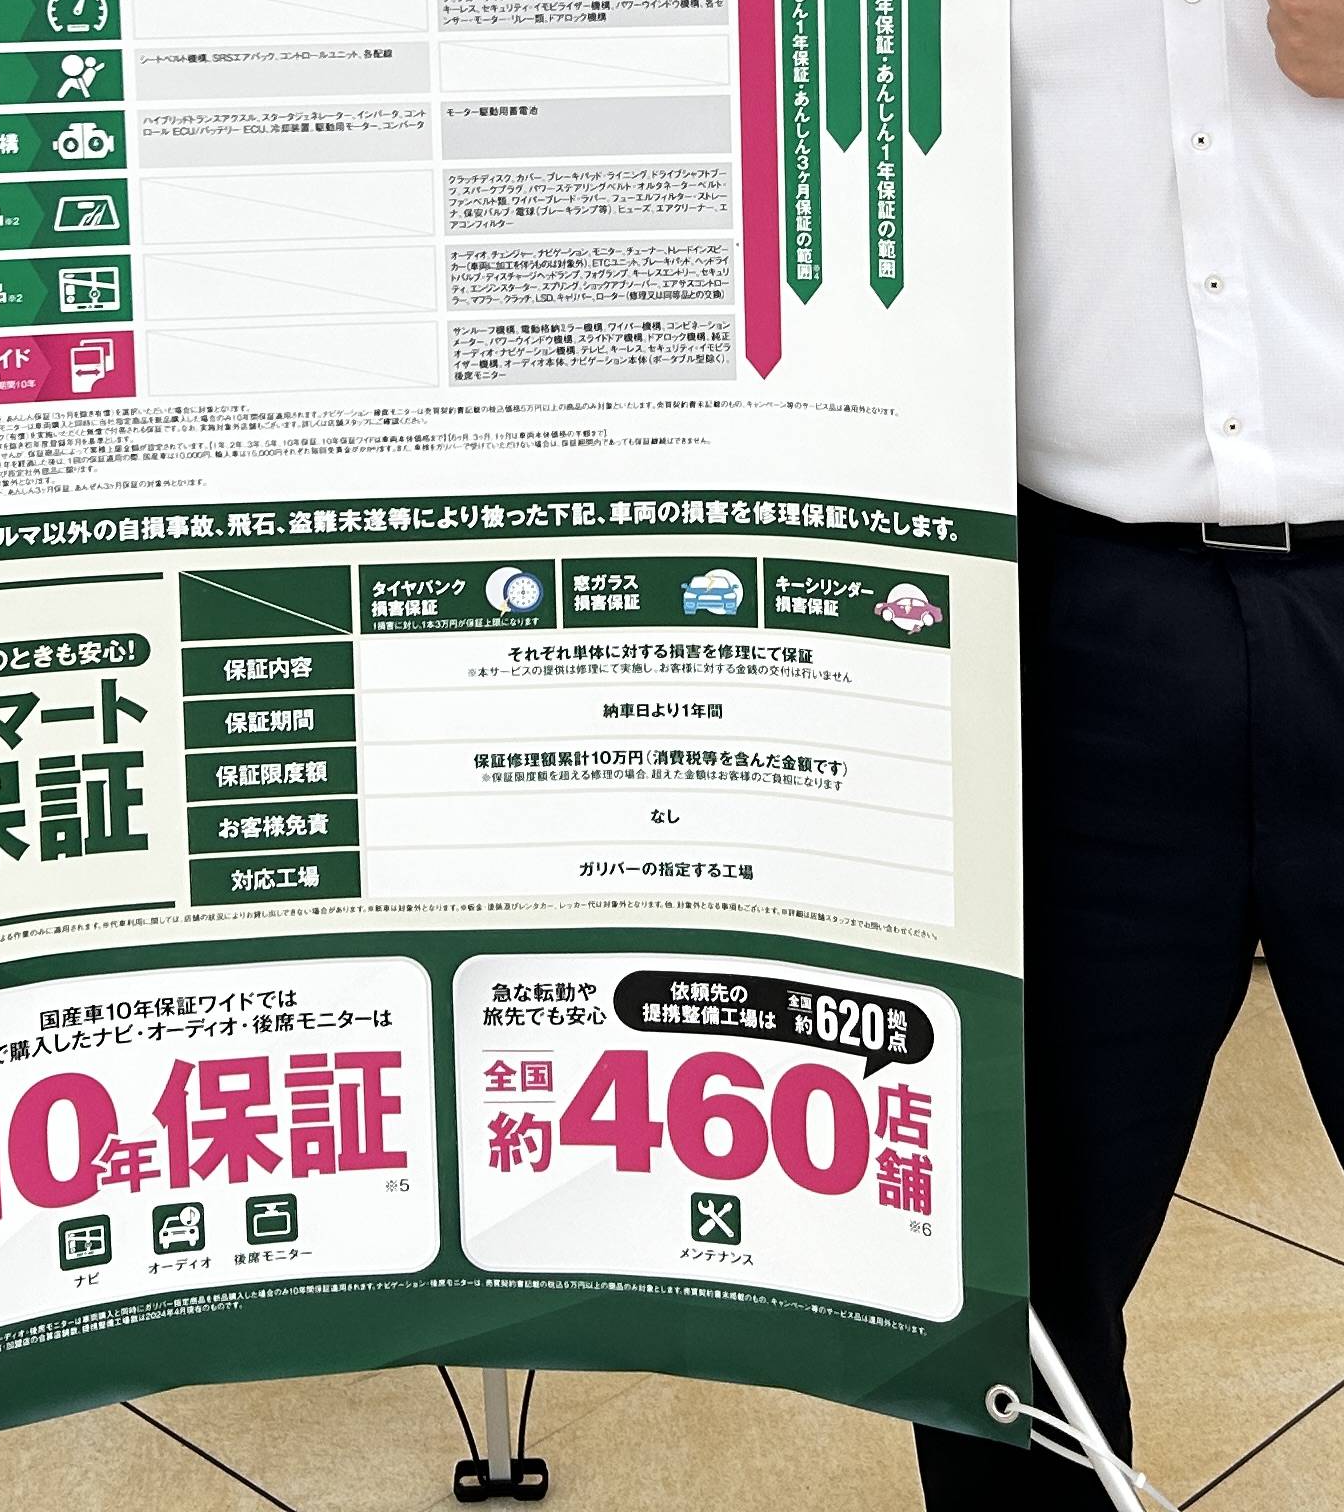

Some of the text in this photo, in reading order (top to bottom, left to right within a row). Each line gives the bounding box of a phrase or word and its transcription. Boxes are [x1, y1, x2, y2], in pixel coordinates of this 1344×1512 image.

[573, 574, 640, 592] 窓ガラス
[775, 576, 875, 598] キーシリンダー
[371, 598, 439, 617] 損害保証
[573, 592, 641, 612] 損害保証
[775, 594, 840, 618] 損害保証
[223, 655, 313, 681] 保証内容
[224, 708, 314, 734] 保証期間
[602, 702, 723, 721] 納車日より1年間
[215, 760, 328, 788] 保証限度額
[217, 813, 329, 839] お客様免責
[650, 808, 680, 825] なし
[230, 867, 319, 892] 対応工場
[578, 860, 754, 881] ガリバーの指定する工場
[491, 982, 597, 1004] 急な転勤や
[670, 981, 748, 1003] 依頼先の
[39, 990, 298, 1030] 国産車10年保証ワイドでは
[482, 1005, 607, 1027] 旅先でも安心
[642, 1001, 777, 1030] 提携整備工場は
[148, 1256, 212, 1272] オーディオ
[234, 1248, 312, 1267] 後席モニター
[679, 1248, 754, 1266] メンテナンス
[74, 1272, 99, 1288] ナビ
